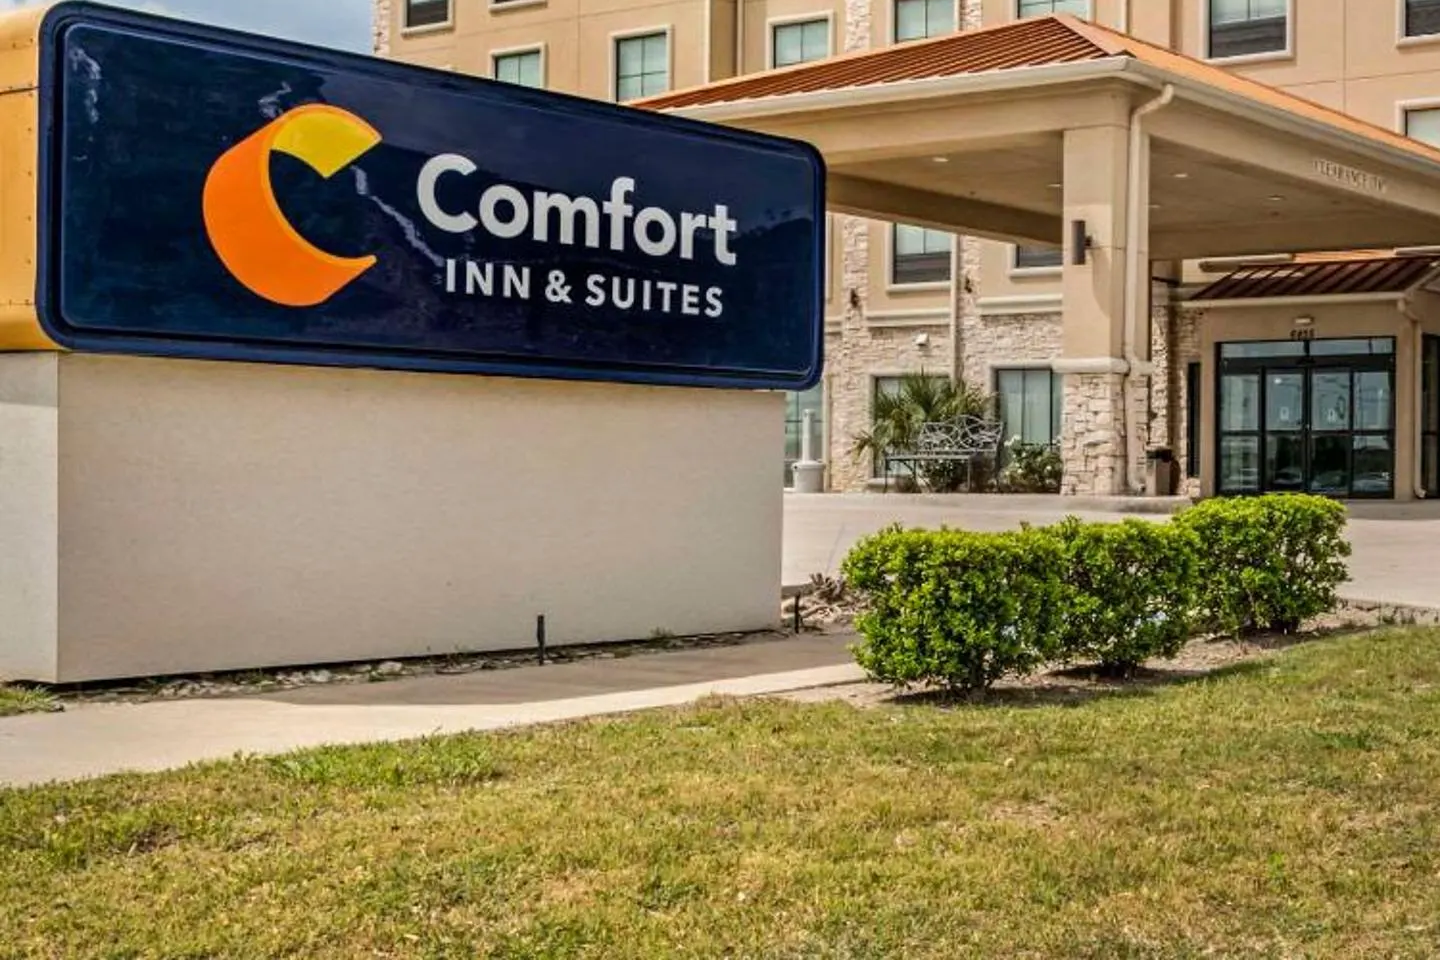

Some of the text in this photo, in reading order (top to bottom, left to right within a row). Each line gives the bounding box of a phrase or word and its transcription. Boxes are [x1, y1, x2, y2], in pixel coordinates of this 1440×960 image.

[416, 152, 738, 266] Comfort
[445, 258, 724, 318] INN & SUITES
